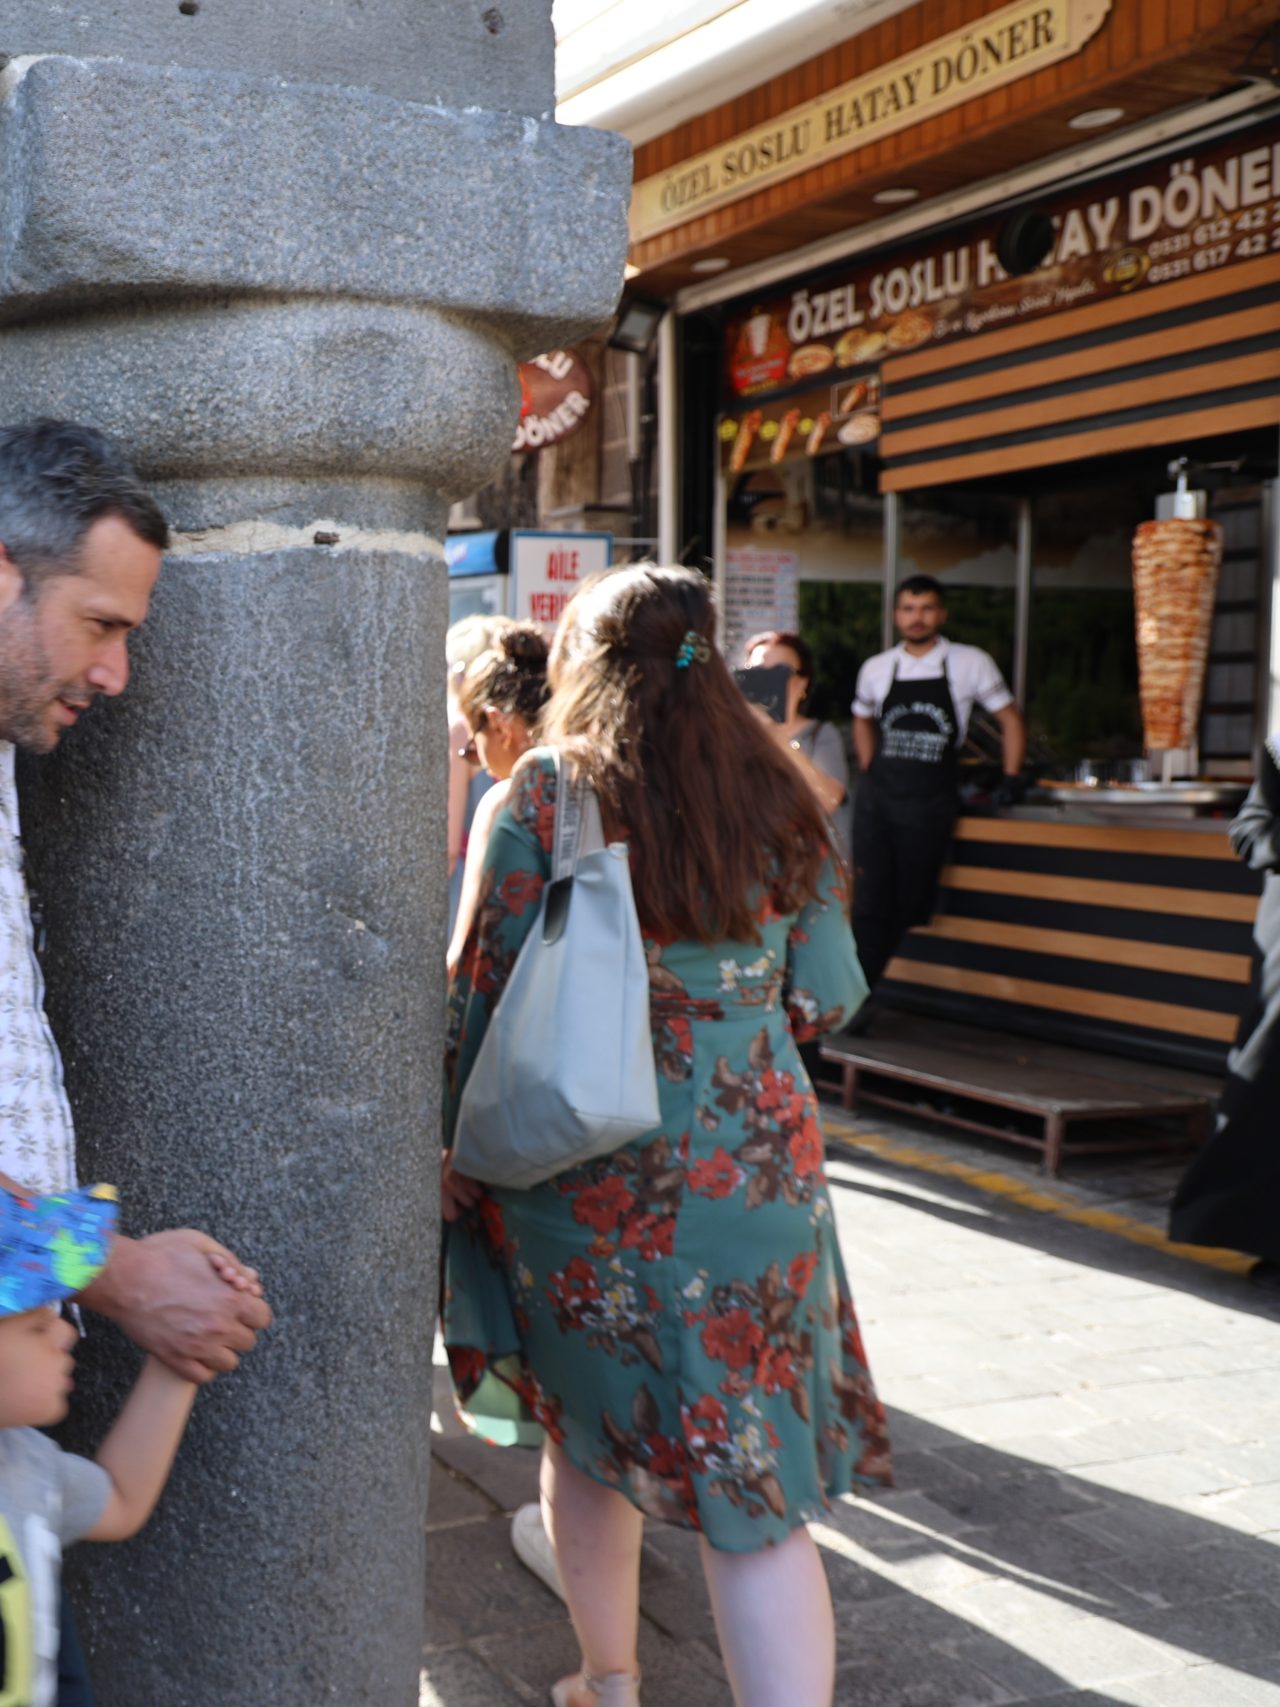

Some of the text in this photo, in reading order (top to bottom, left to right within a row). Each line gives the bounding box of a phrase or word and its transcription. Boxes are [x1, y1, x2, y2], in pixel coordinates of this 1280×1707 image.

[660, 8, 1055, 212] ÖZEL SOSLU HATAY DÖNER
[1193, 218, 1232, 246] 612
[1235, 208, 1267, 230] 42
[787, 284, 865, 343] ÖZEL
[869, 247, 969, 319] SOSLU
[977, 197, 1119, 286] HAY
[1193, 243, 1232, 271] 617
[1235, 233, 1267, 257] 42
[546, 544, 580, 581] AİLE
